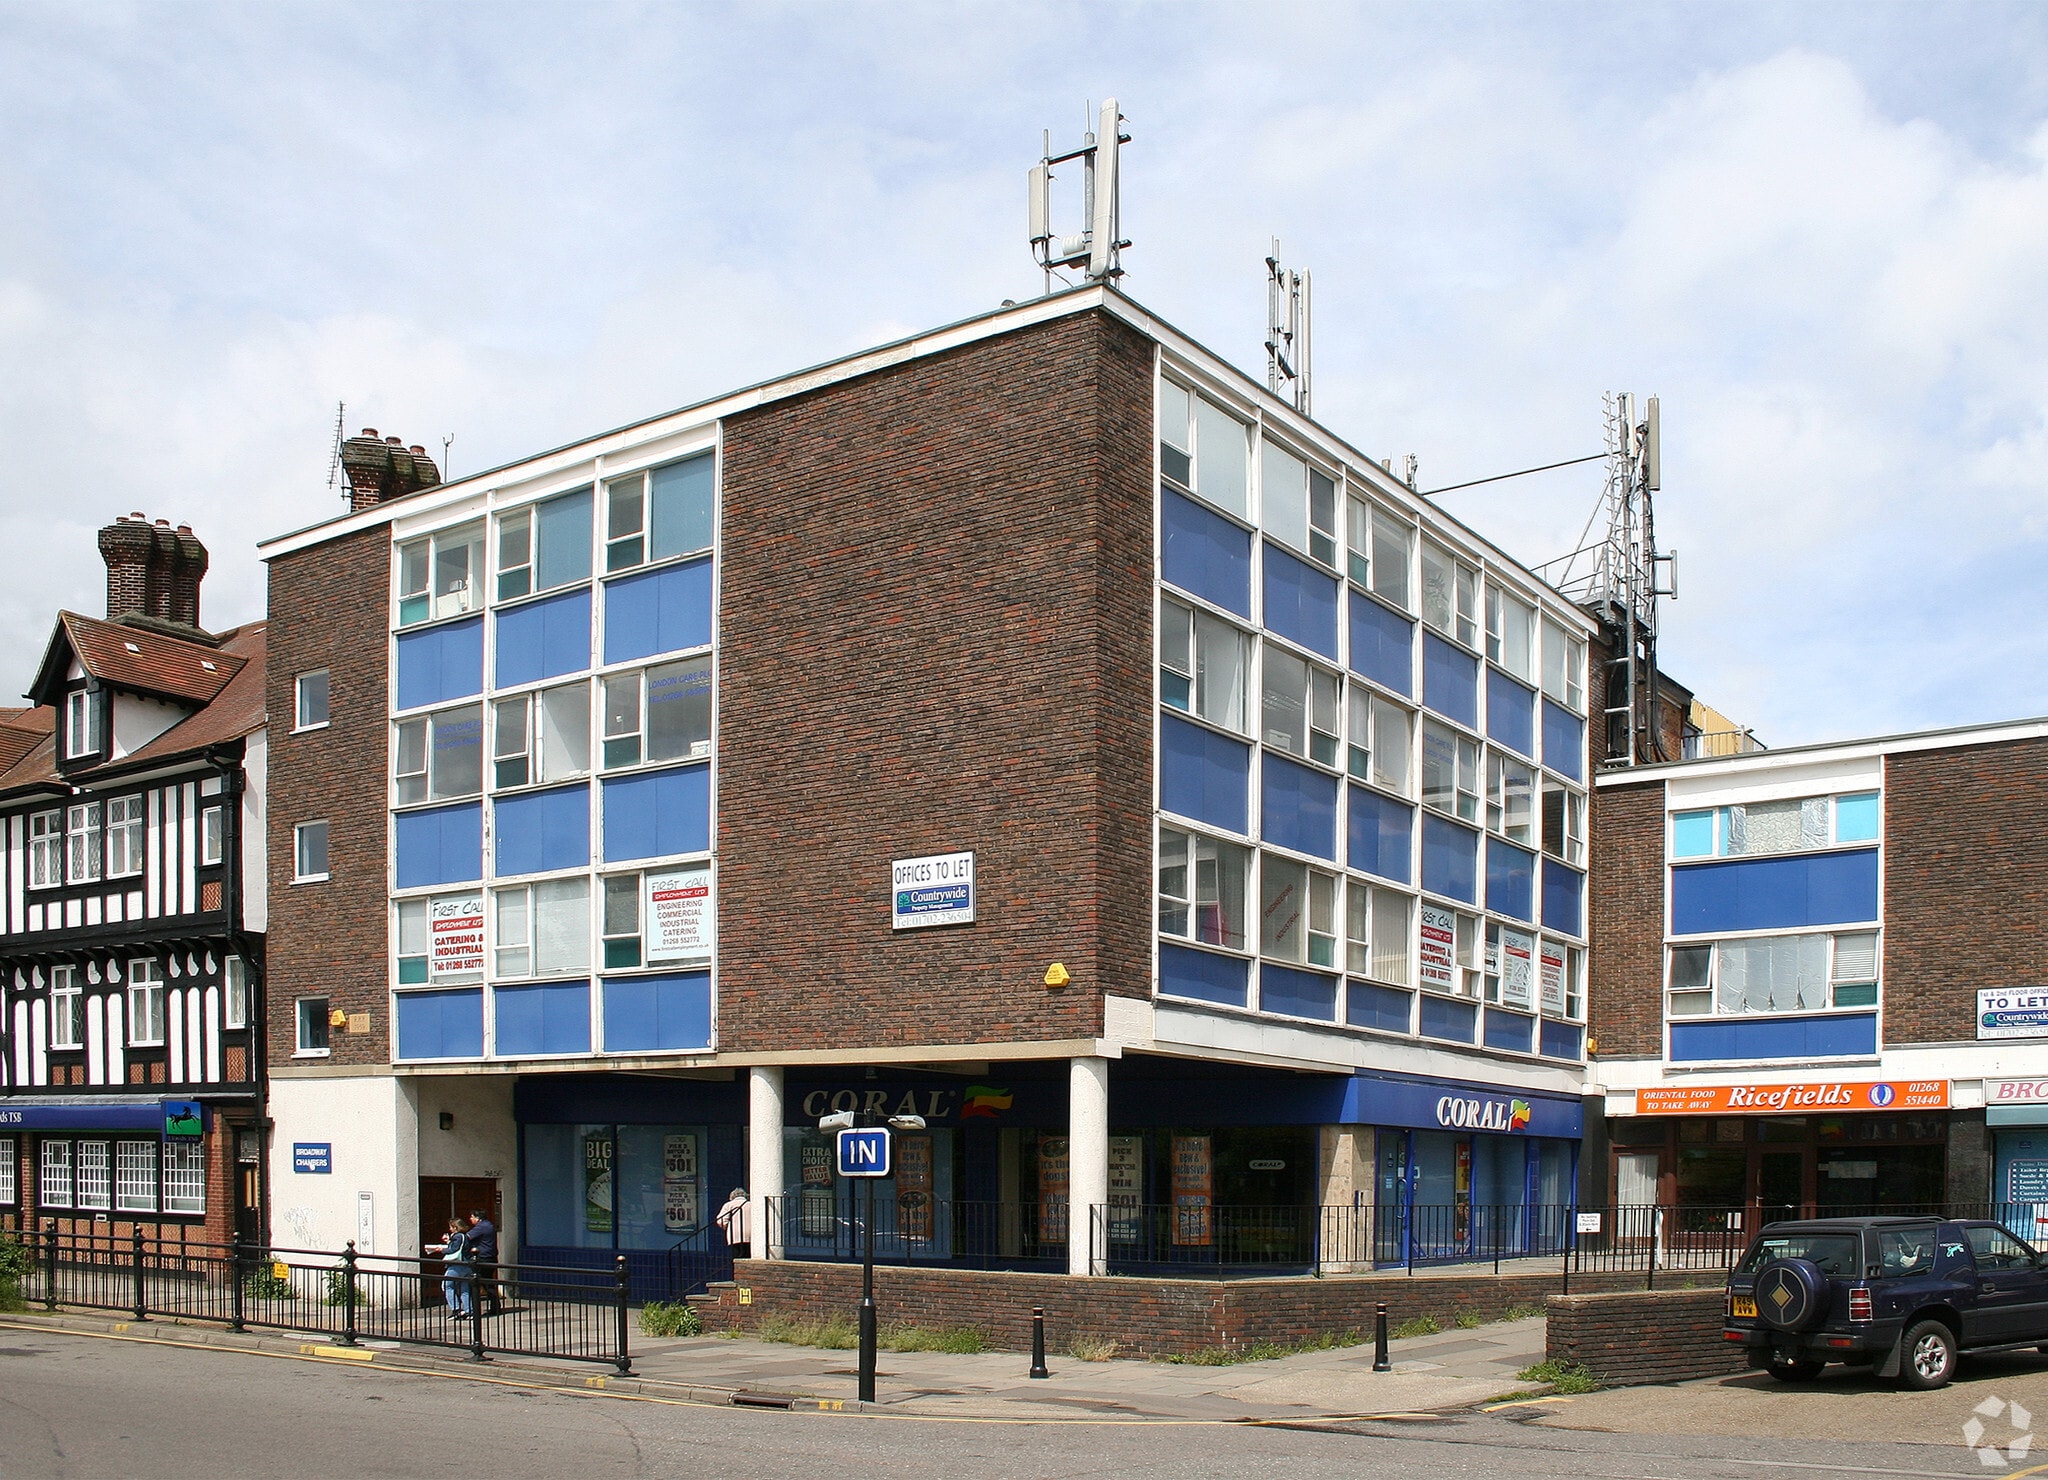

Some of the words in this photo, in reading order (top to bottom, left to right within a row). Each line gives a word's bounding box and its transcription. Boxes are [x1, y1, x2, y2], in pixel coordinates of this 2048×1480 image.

[895, 864, 931, 884] OFFICES
[936, 862, 949, 879] TO
[954, 859, 970, 878] LET
[911, 887, 967, 903] Countrywide
[656, 900, 703, 911] ENGINEERING
[657, 909, 703, 920] COMMERCIAL
[660, 918, 699, 928] INDUSTRIAL
[663, 927, 697, 937] CATERING
[434, 934, 476, 946] CATERING
[435, 944, 483, 957] INDUSTRIAL
[1985, 998, 2009, 1008] TO
[2017, 996, 2048, 1007] LET
[1909, 1082, 1940, 1092] 01268
[1643, 1091, 1687, 1099] ORIENTAL
[1690, 1090, 1716, 1098] FOOD
[1727, 1084, 1853, 1110] Ricefields
[1904, 1094, 1941, 1105] 551440
[803, 1089, 950, 1117] CORAL
[1647, 1102, 1659, 1110] TO
[1687, 1101, 1712, 1109] AWAY
[9, 1111, 22, 1123] TSB
[1437, 1096, 1507, 1130] CORAL
[296, 1148, 327, 1156] BROADWAY
[586, 1141, 612, 1158] BIG
[803, 1147, 831, 1157] EXTRA
[850, 1139, 877, 1164] IN
[296, 1158, 327, 1167] CHAMBERS
[587, 1159, 609, 1168] DEAL
[803, 1157, 831, 1165] CHOICE
[741, 1290, 750, 1302] H
